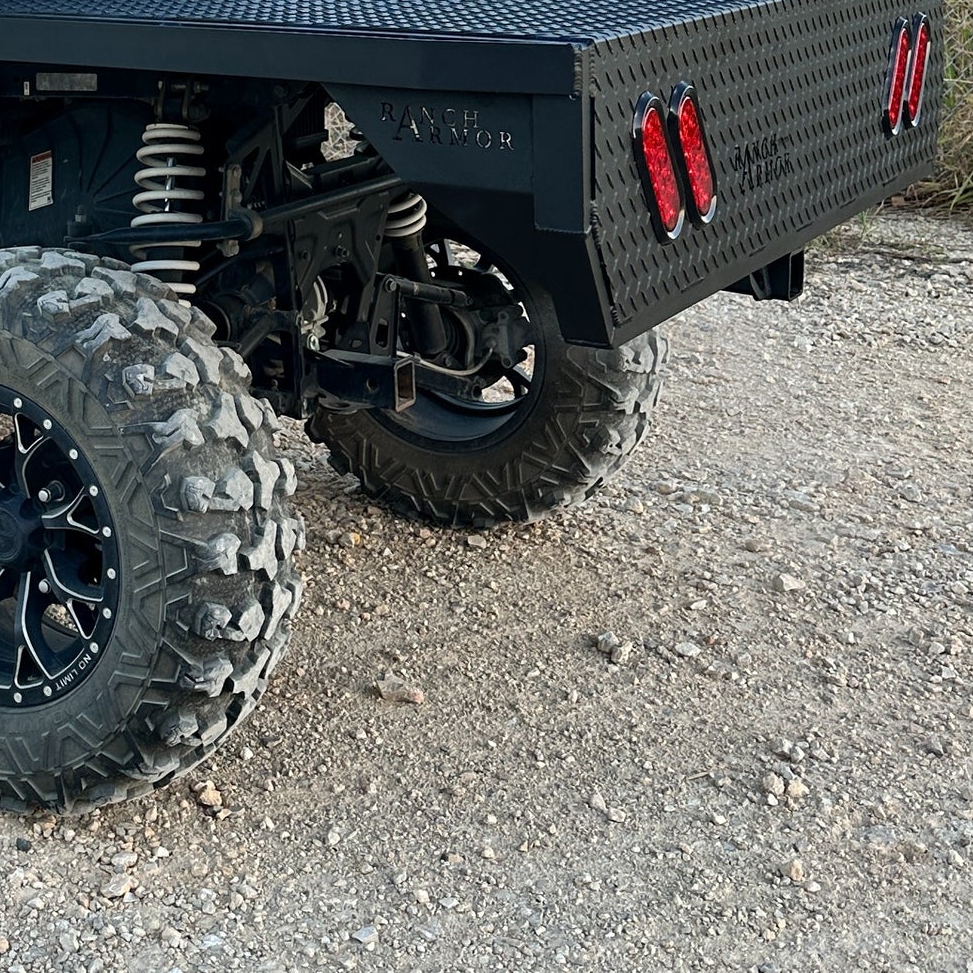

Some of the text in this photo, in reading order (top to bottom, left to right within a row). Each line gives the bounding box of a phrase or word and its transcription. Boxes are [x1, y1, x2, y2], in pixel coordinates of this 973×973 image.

[380, 102, 478, 128] RANCH
[393, 105, 514, 150] ARMOR
[731, 134, 778, 172] RANCH
[55, 653, 92, 691] NO LIMIT
